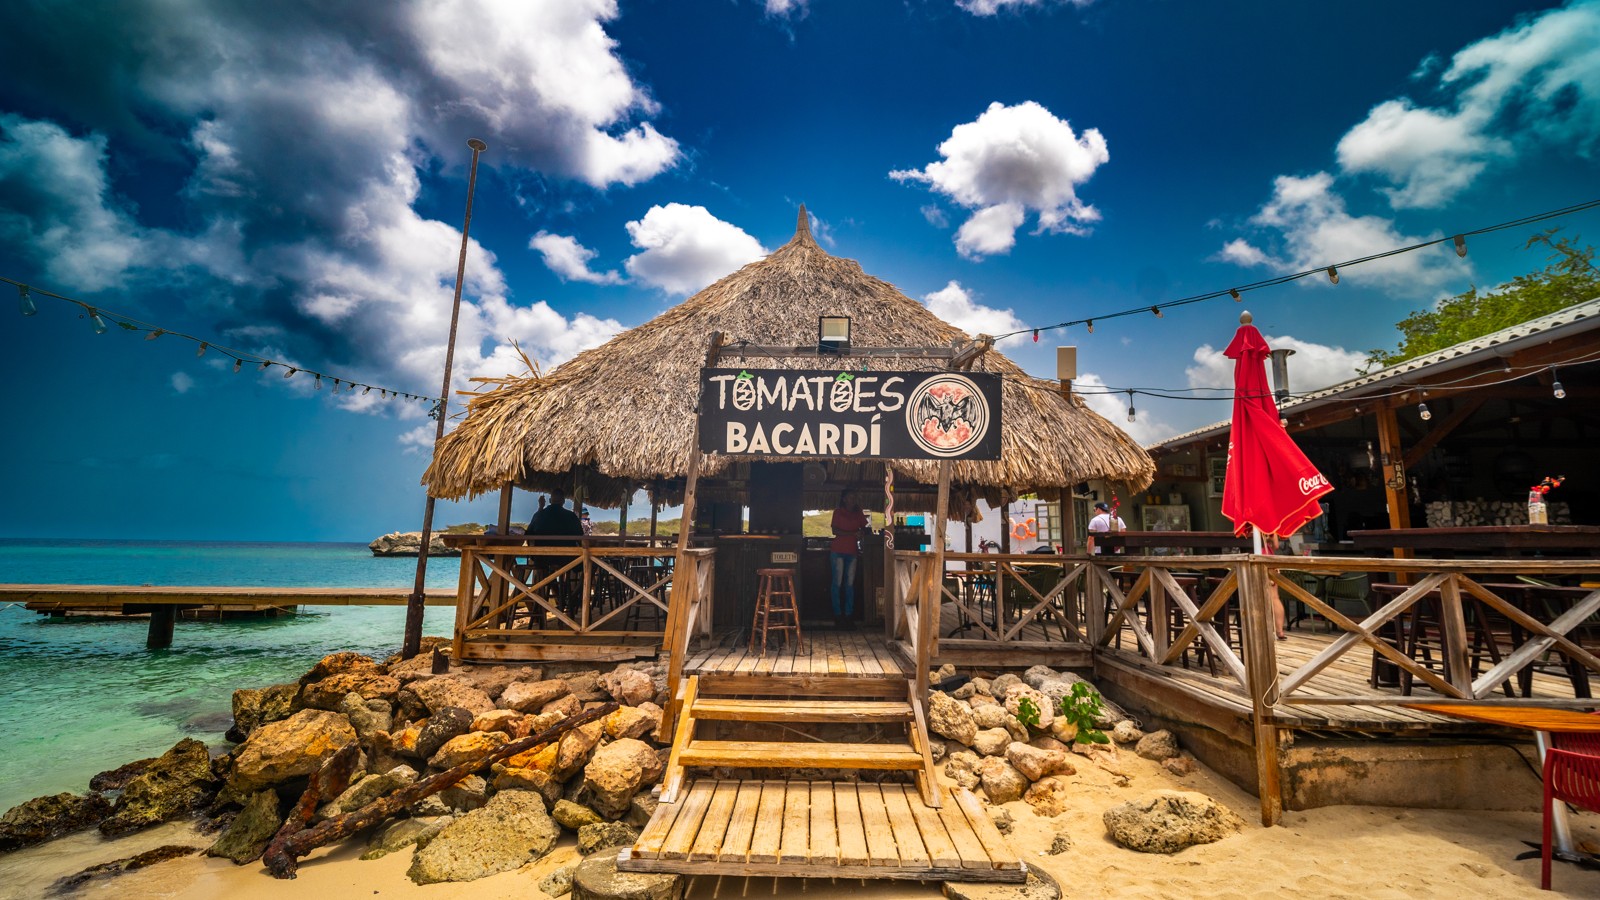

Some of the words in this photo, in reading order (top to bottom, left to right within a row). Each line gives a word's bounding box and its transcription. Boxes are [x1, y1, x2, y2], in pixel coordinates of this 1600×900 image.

[709, 373, 905, 412] TOMATOES
[726, 414, 881, 456] BACARDÍ
[1395, 465, 1403, 484] BAR
